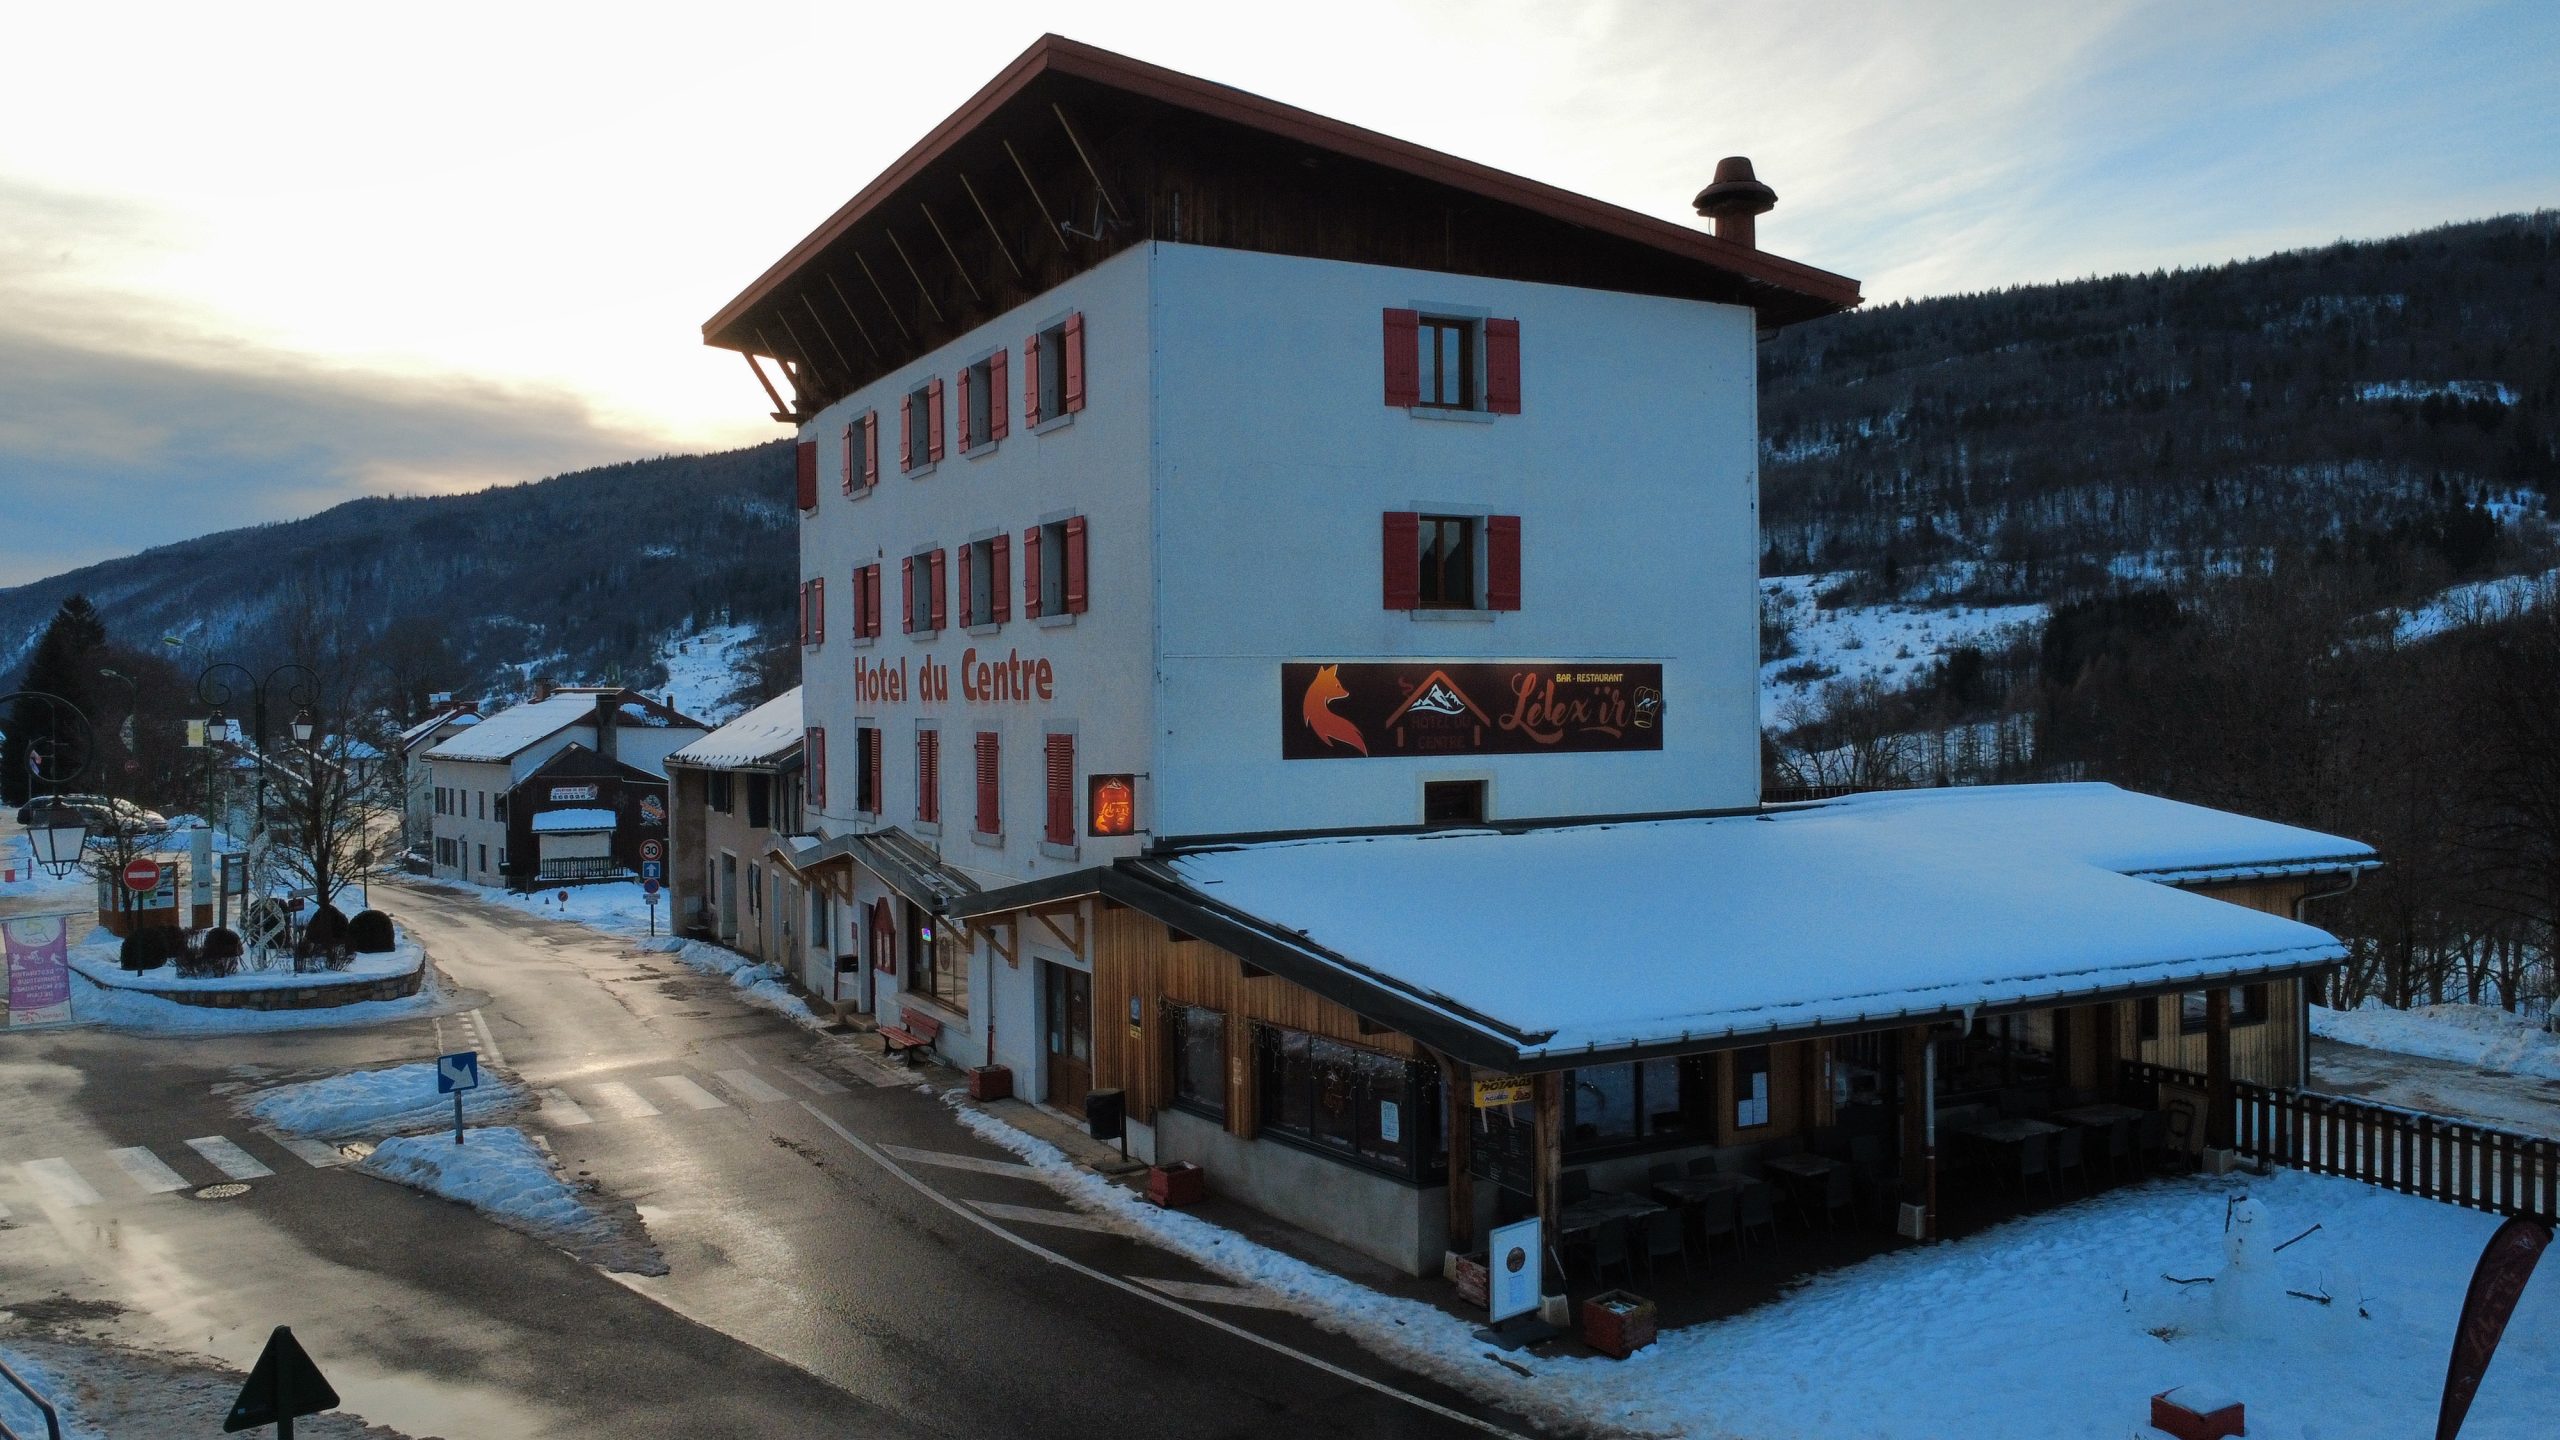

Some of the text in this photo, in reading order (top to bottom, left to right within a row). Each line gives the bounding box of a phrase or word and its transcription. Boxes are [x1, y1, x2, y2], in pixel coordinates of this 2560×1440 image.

[855, 648, 1053, 701] Hotel du Centre
[1556, 673, 1571, 682] BAR
[1577, 673, 1623, 682] RESTAURANT
[1418, 735, 1465, 749] CENTRE
[645, 846, 658, 856] 30
[1479, 1078, 1532, 1092] MOTARDS
